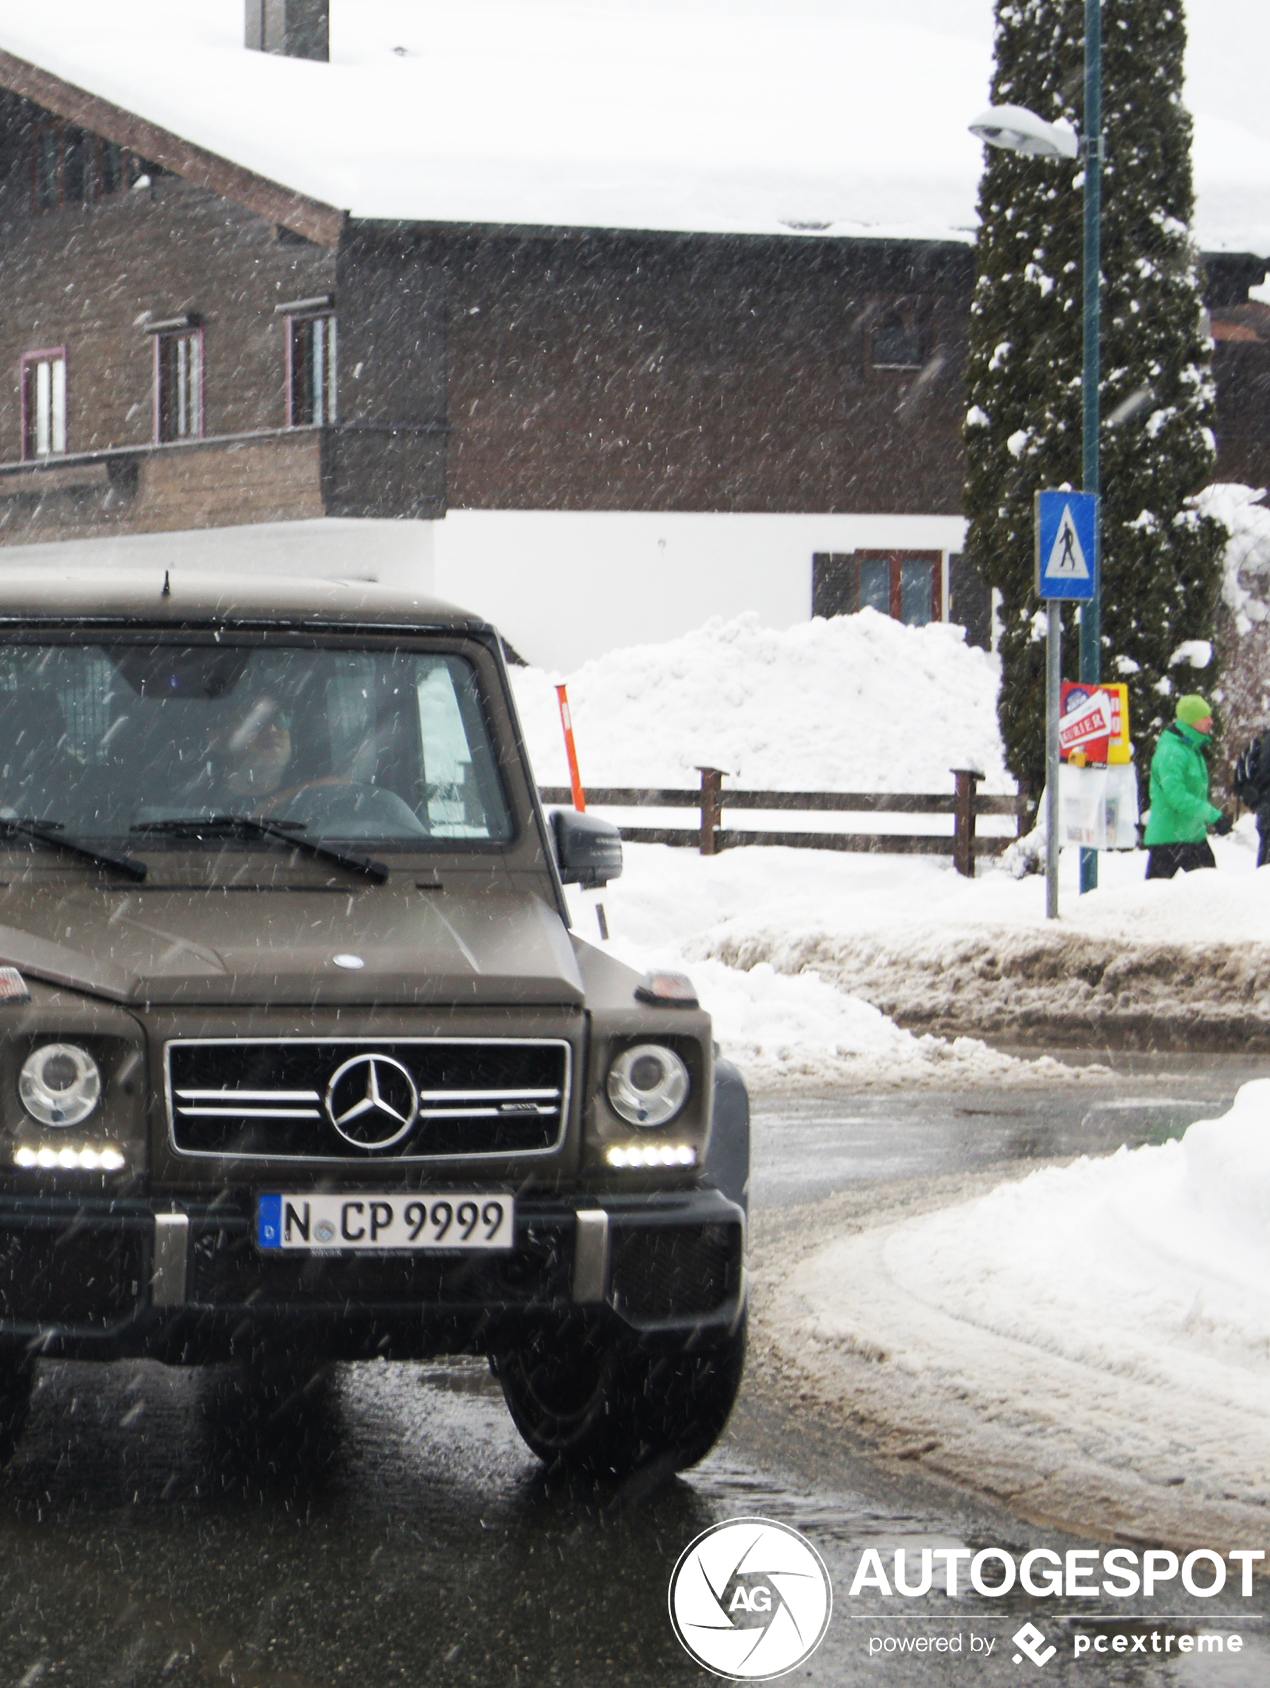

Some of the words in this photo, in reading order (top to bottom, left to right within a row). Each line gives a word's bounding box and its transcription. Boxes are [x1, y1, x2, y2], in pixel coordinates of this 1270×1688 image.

[1061, 713, 1104, 740] KURIER
[264, 1225, 275, 1239] D
[284, 1202, 310, 1242] N
[341, 1202, 394, 1242] CP
[404, 1202, 504, 1242] 9999
